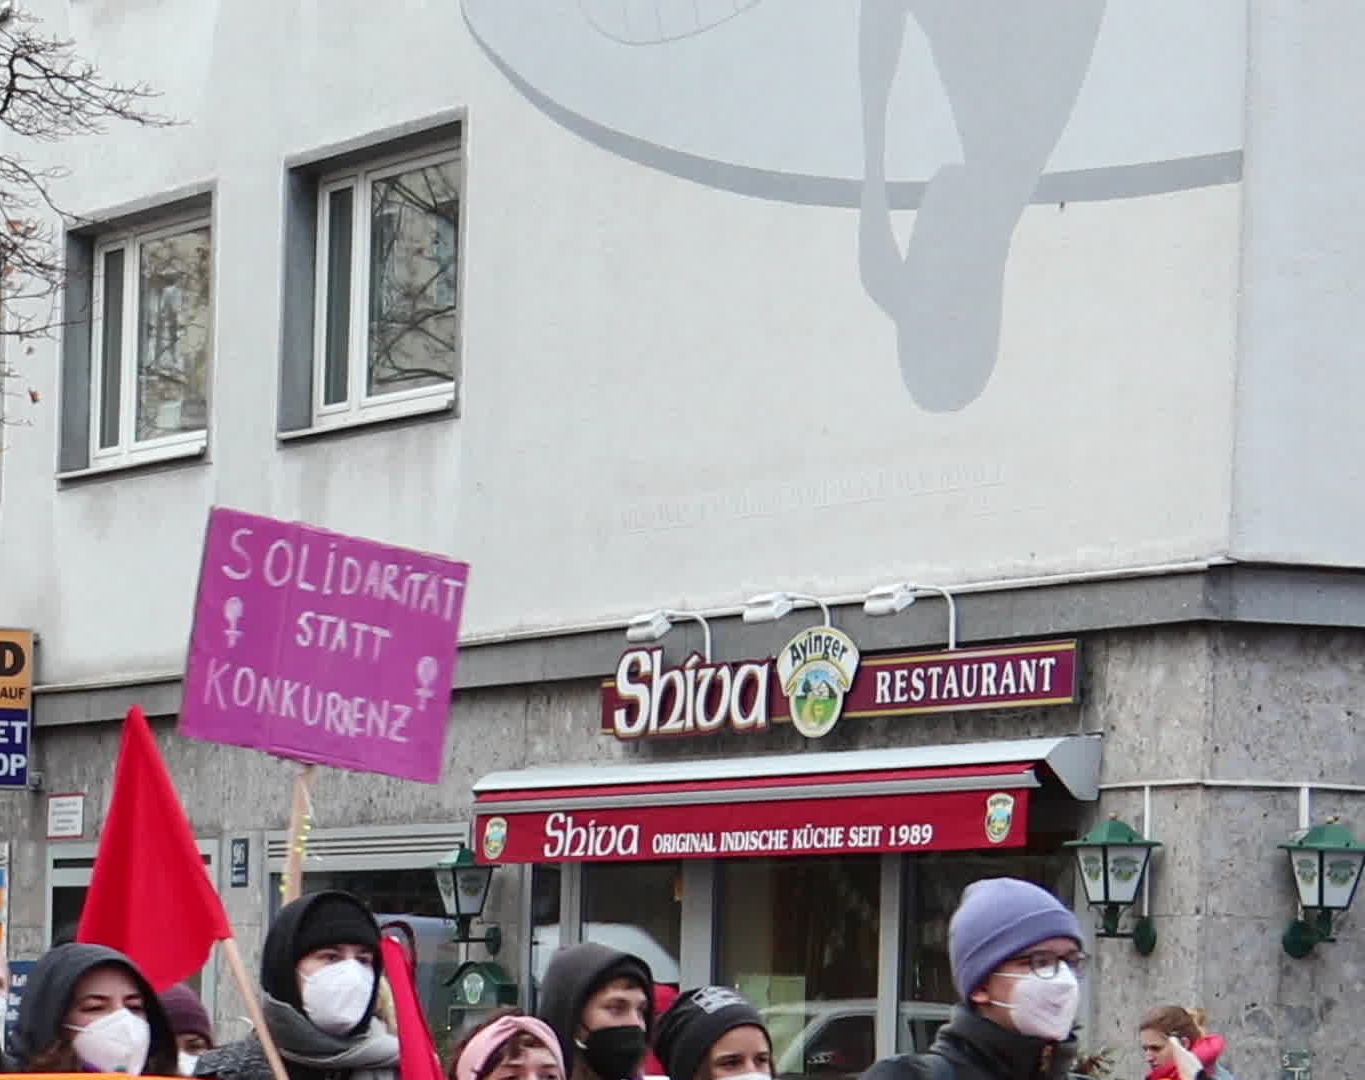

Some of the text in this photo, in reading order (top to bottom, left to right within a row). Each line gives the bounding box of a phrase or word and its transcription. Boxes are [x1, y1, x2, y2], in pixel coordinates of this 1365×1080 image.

[295, 611, 392, 662] STATT
[789, 631, 849, 663] Ayinger
[613, 646, 1056, 736] Shiva RESTAURANT
[542, 812, 933, 857] Shiva ORIGINAL INDISCHE KÜCHE SEIT 1989
